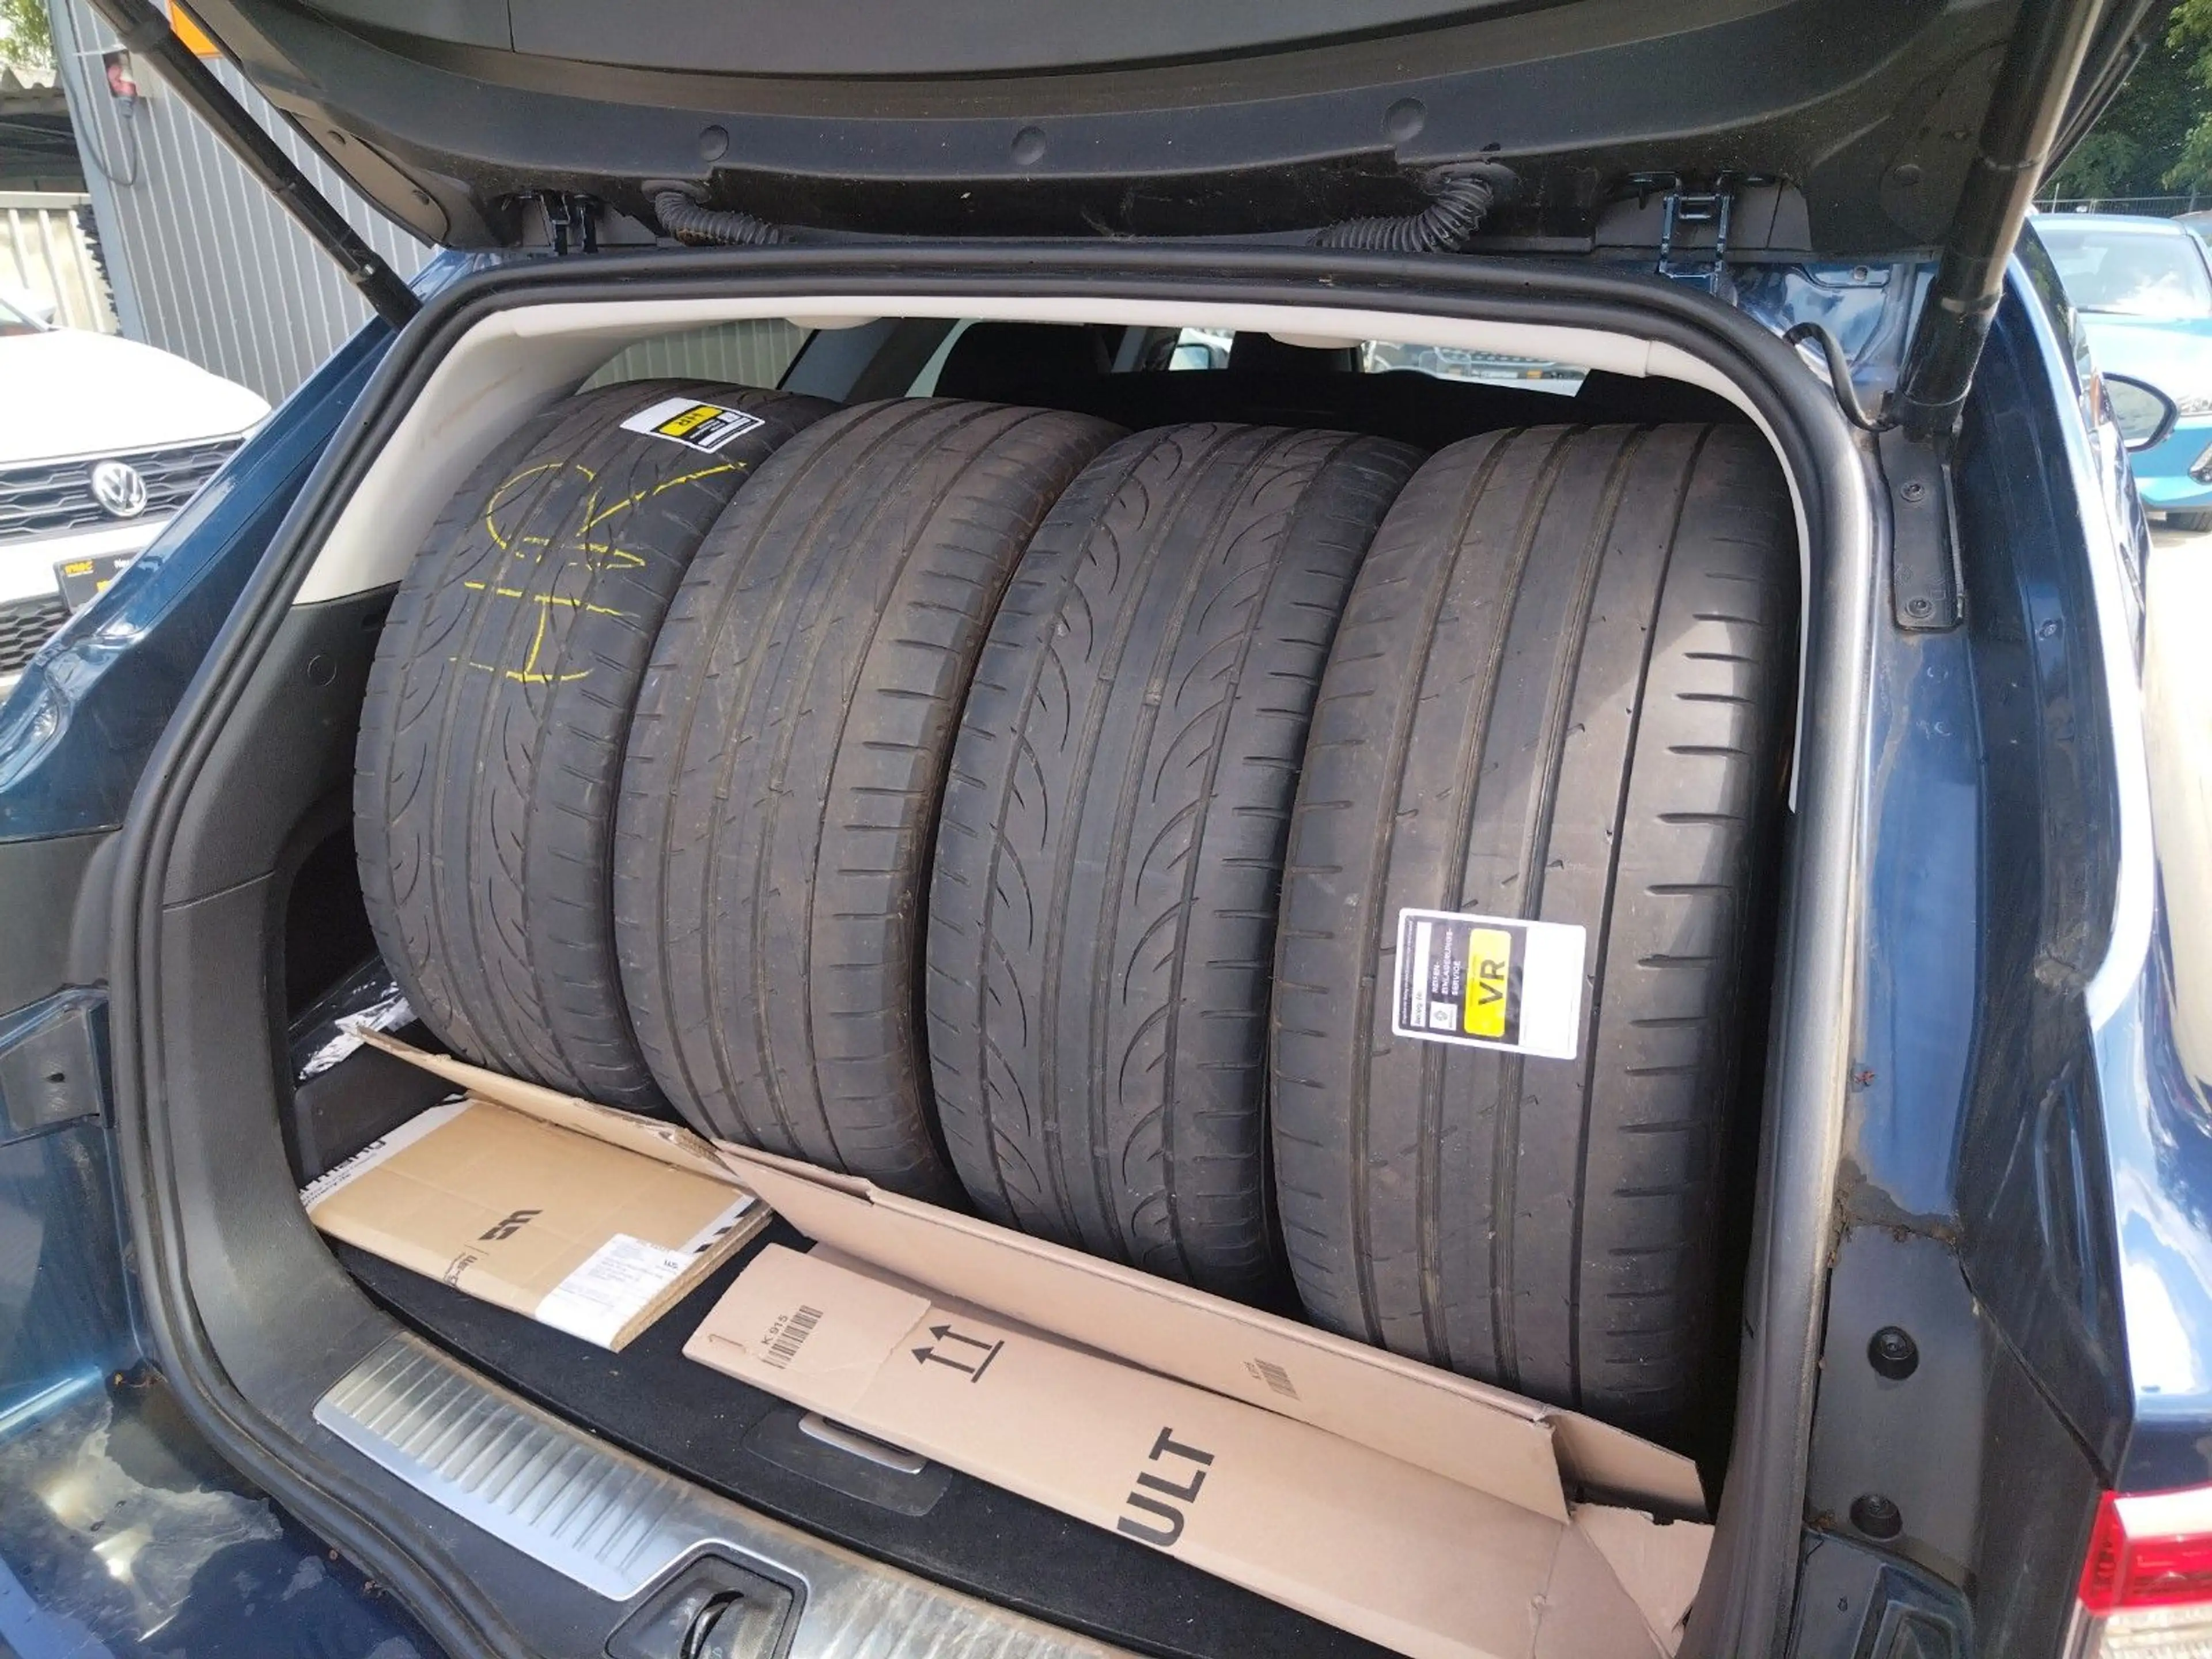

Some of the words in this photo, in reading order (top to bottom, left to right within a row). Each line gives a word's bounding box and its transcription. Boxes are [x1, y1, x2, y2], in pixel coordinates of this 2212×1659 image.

[1451, 960, 1461, 996] SERVICE
[1478, 959, 1505, 1006] VR
[760, 1335, 773, 1345] K
[769, 1314, 788, 1335] 915
[1116, 1426, 1215, 1547] ULT
